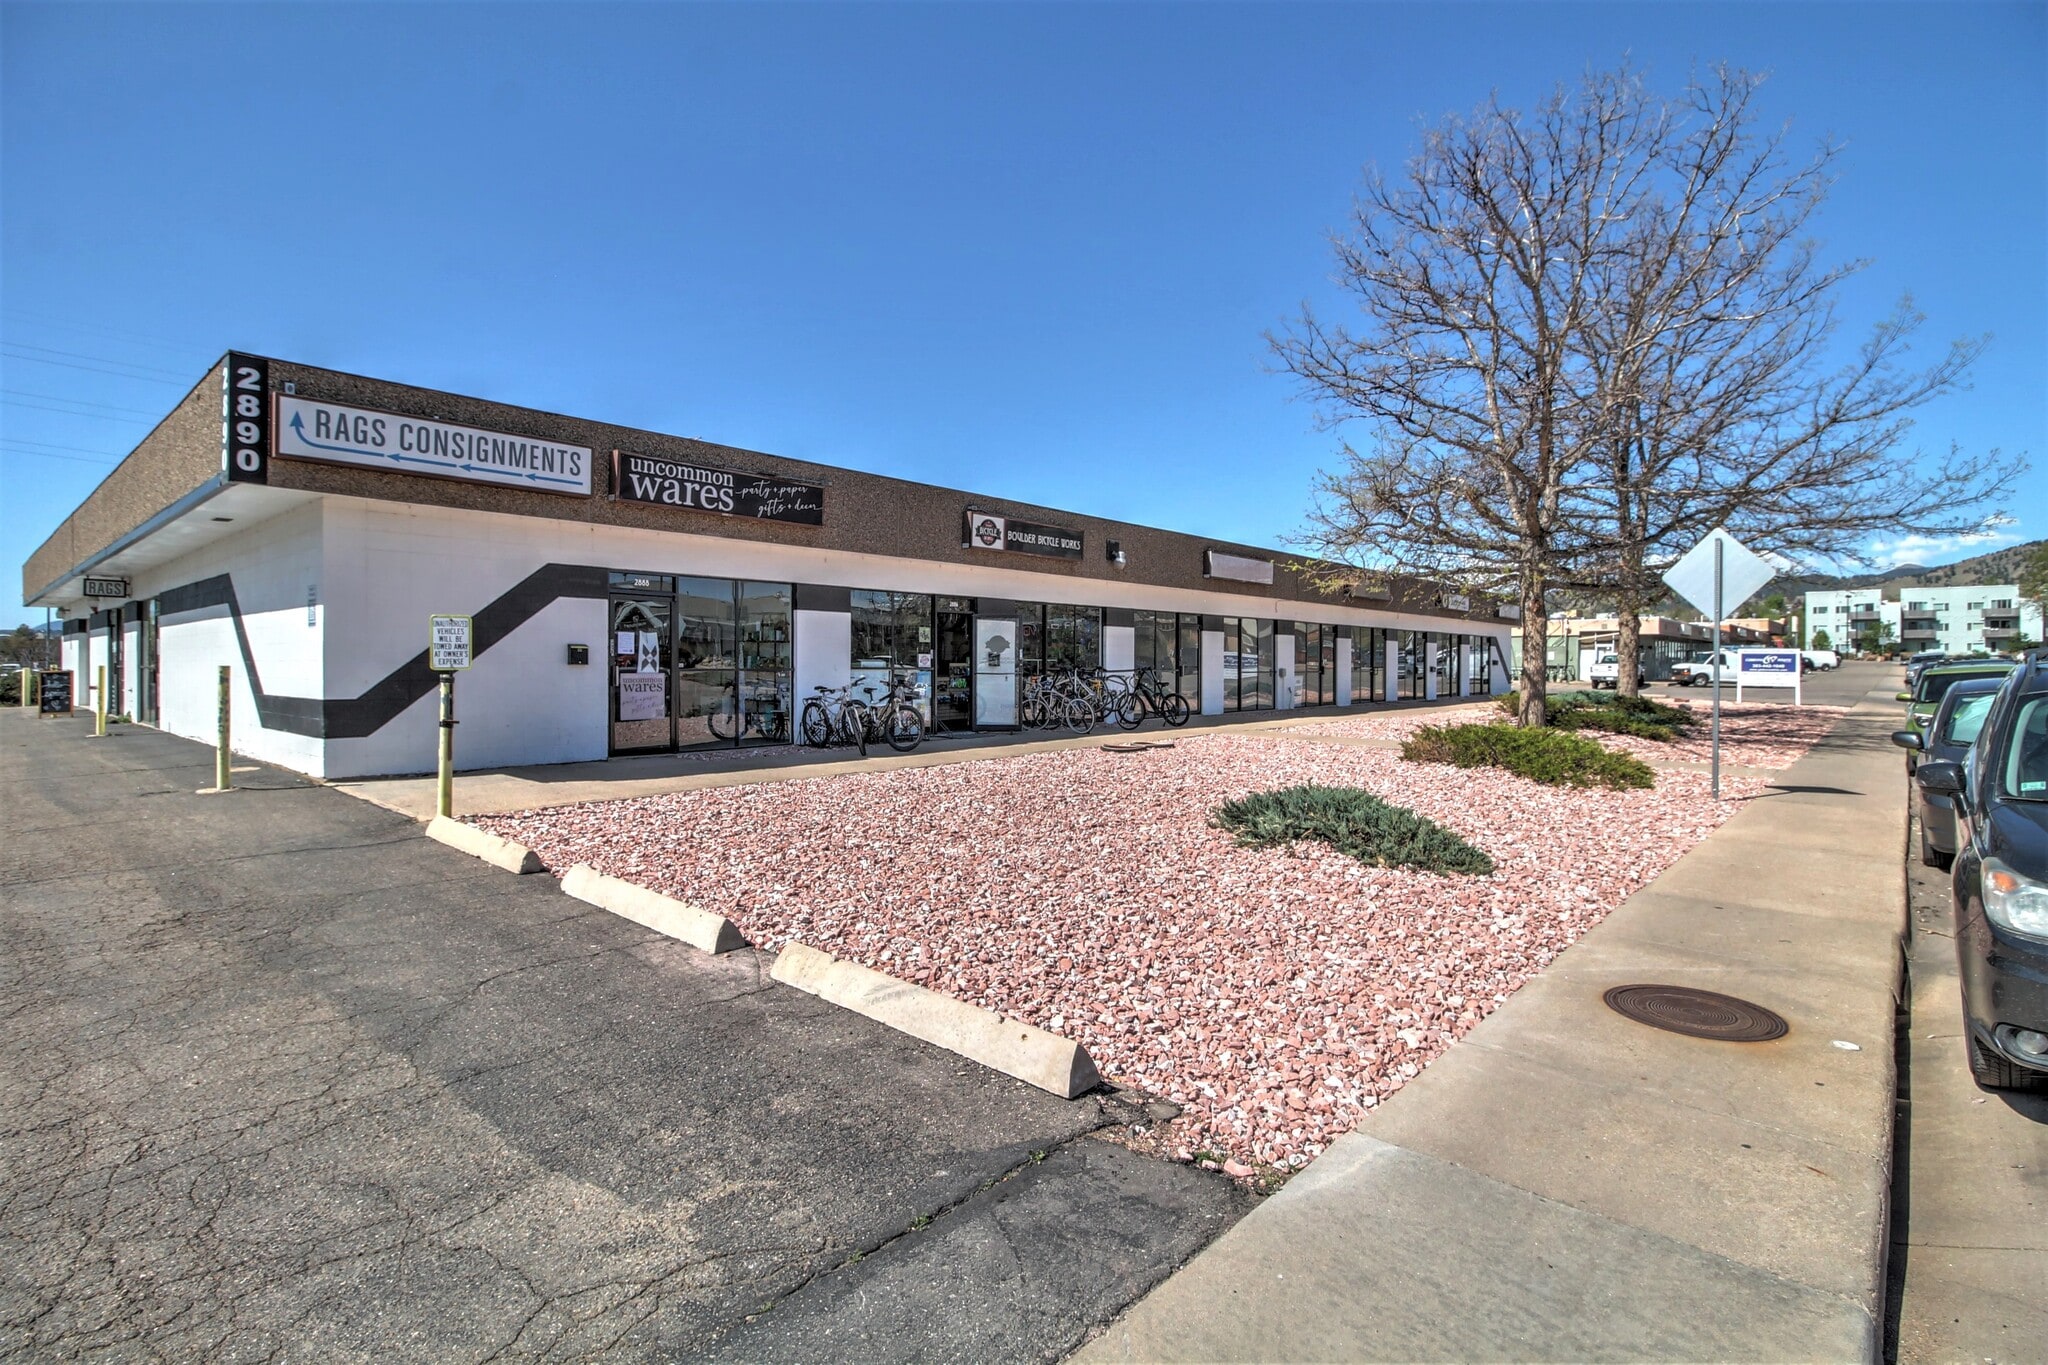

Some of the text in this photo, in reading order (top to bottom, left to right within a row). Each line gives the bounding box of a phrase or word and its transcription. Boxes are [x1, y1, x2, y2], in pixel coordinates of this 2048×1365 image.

[236, 366, 261, 472] 2890
[315, 408, 582, 477] RAGS CONSIGNMENTS
[630, 457, 734, 488] uncommon
[629, 473, 734, 512] wares
[736, 480, 771, 499] party
[777, 486, 808, 498] paper
[758, 498, 786, 517] gifts
[1007, 530, 1036, 545] BOULDER
[1037, 534, 1060, 548] BICYCLE
[1060, 538, 1080, 550] WORKS
[88, 581, 122, 595] RAGS
[623, 682, 663, 692] wares
